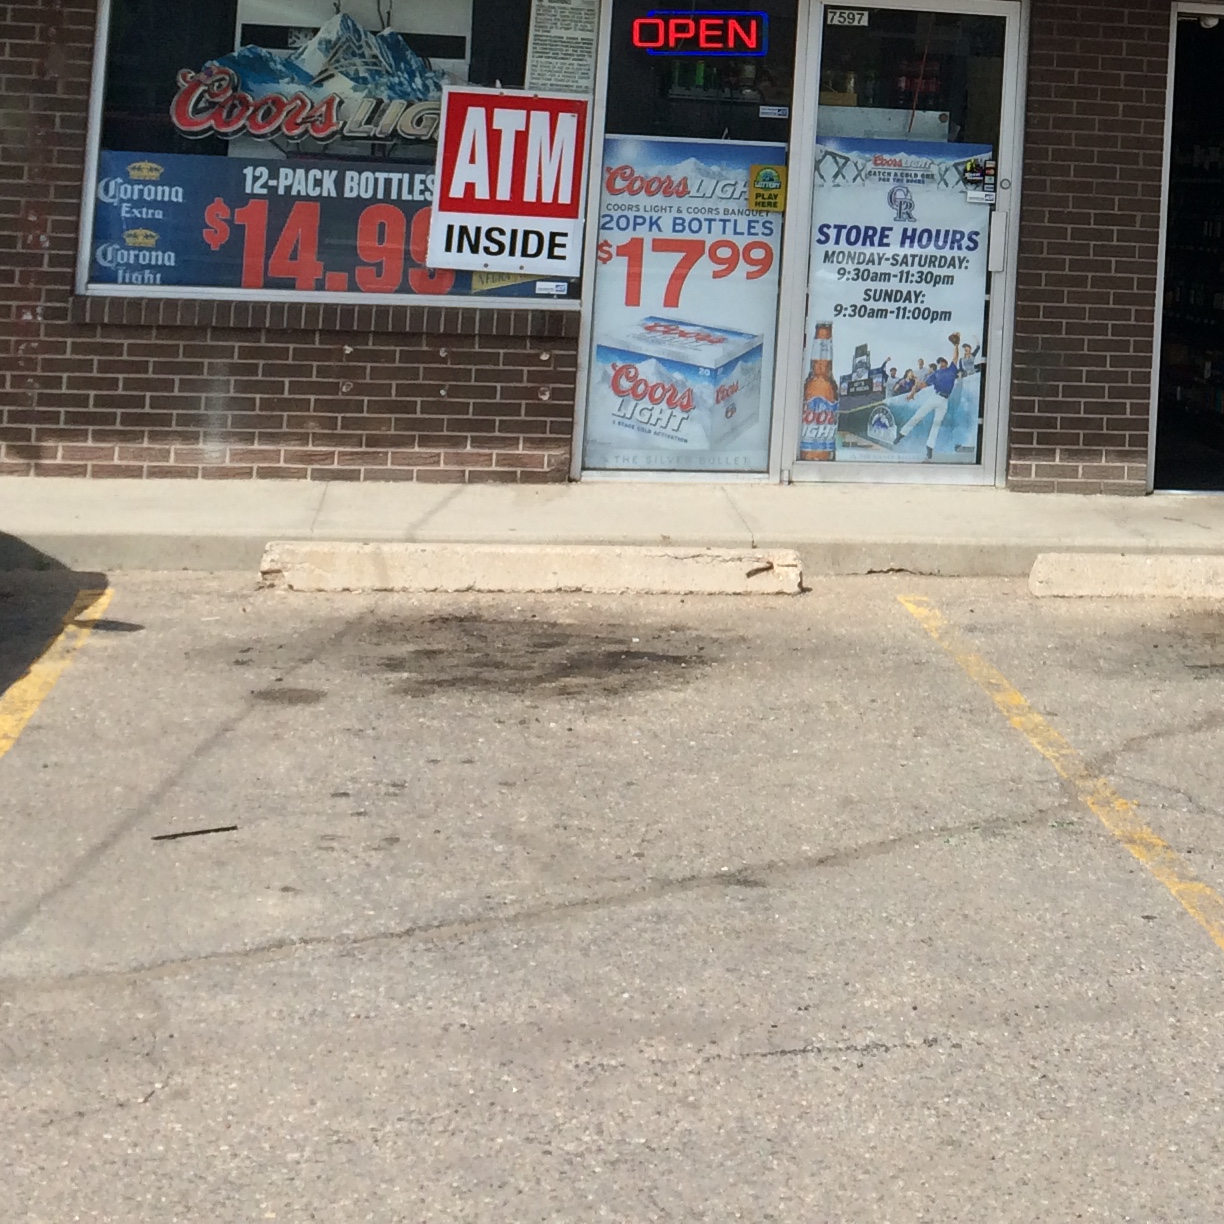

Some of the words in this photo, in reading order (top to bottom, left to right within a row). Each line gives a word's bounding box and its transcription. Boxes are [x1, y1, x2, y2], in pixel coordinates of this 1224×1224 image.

[828, 10, 865, 26] 7597
[632, 18, 758, 49] OPEN
[170, 66, 344, 144] Coors
[341, 97, 440, 142] LIG
[448, 106, 579, 205] ATM
[97, 177, 185, 206] Corona
[243, 165, 338, 198] 12-PACK
[605, 164, 691, 199] Coors
[688, 178, 750, 201] LIGH
[606, 202, 640, 213] COORS
[643, 204, 674, 215] LIGHT
[676, 206, 683, 215] &
[686, 206, 720, 216] COORS
[754, 200, 778, 208] HERE
[755, 192, 779, 200] PLAY
[121, 202, 163, 220] Extra
[600, 213, 663, 233] 20PK
[671, 216, 774, 237] BOTTLES
[816, 223, 894, 248] STORE
[900, 227, 981, 252] HOURS
[444, 224, 569, 261] INSIDE
[96, 242, 176, 270] Corona
[823, 250, 970, 270] MONDAY-SATURDAY:
[836, 267, 955, 287] 9:30am-11:30pm
[862, 288, 926, 304] SUNDAY:
[833, 303, 952, 323] 9:30am-11:00pm
[611, 362, 697, 413] Coors
[611, 398, 690, 433] LIGHT
[614, 455, 638, 464] THE
